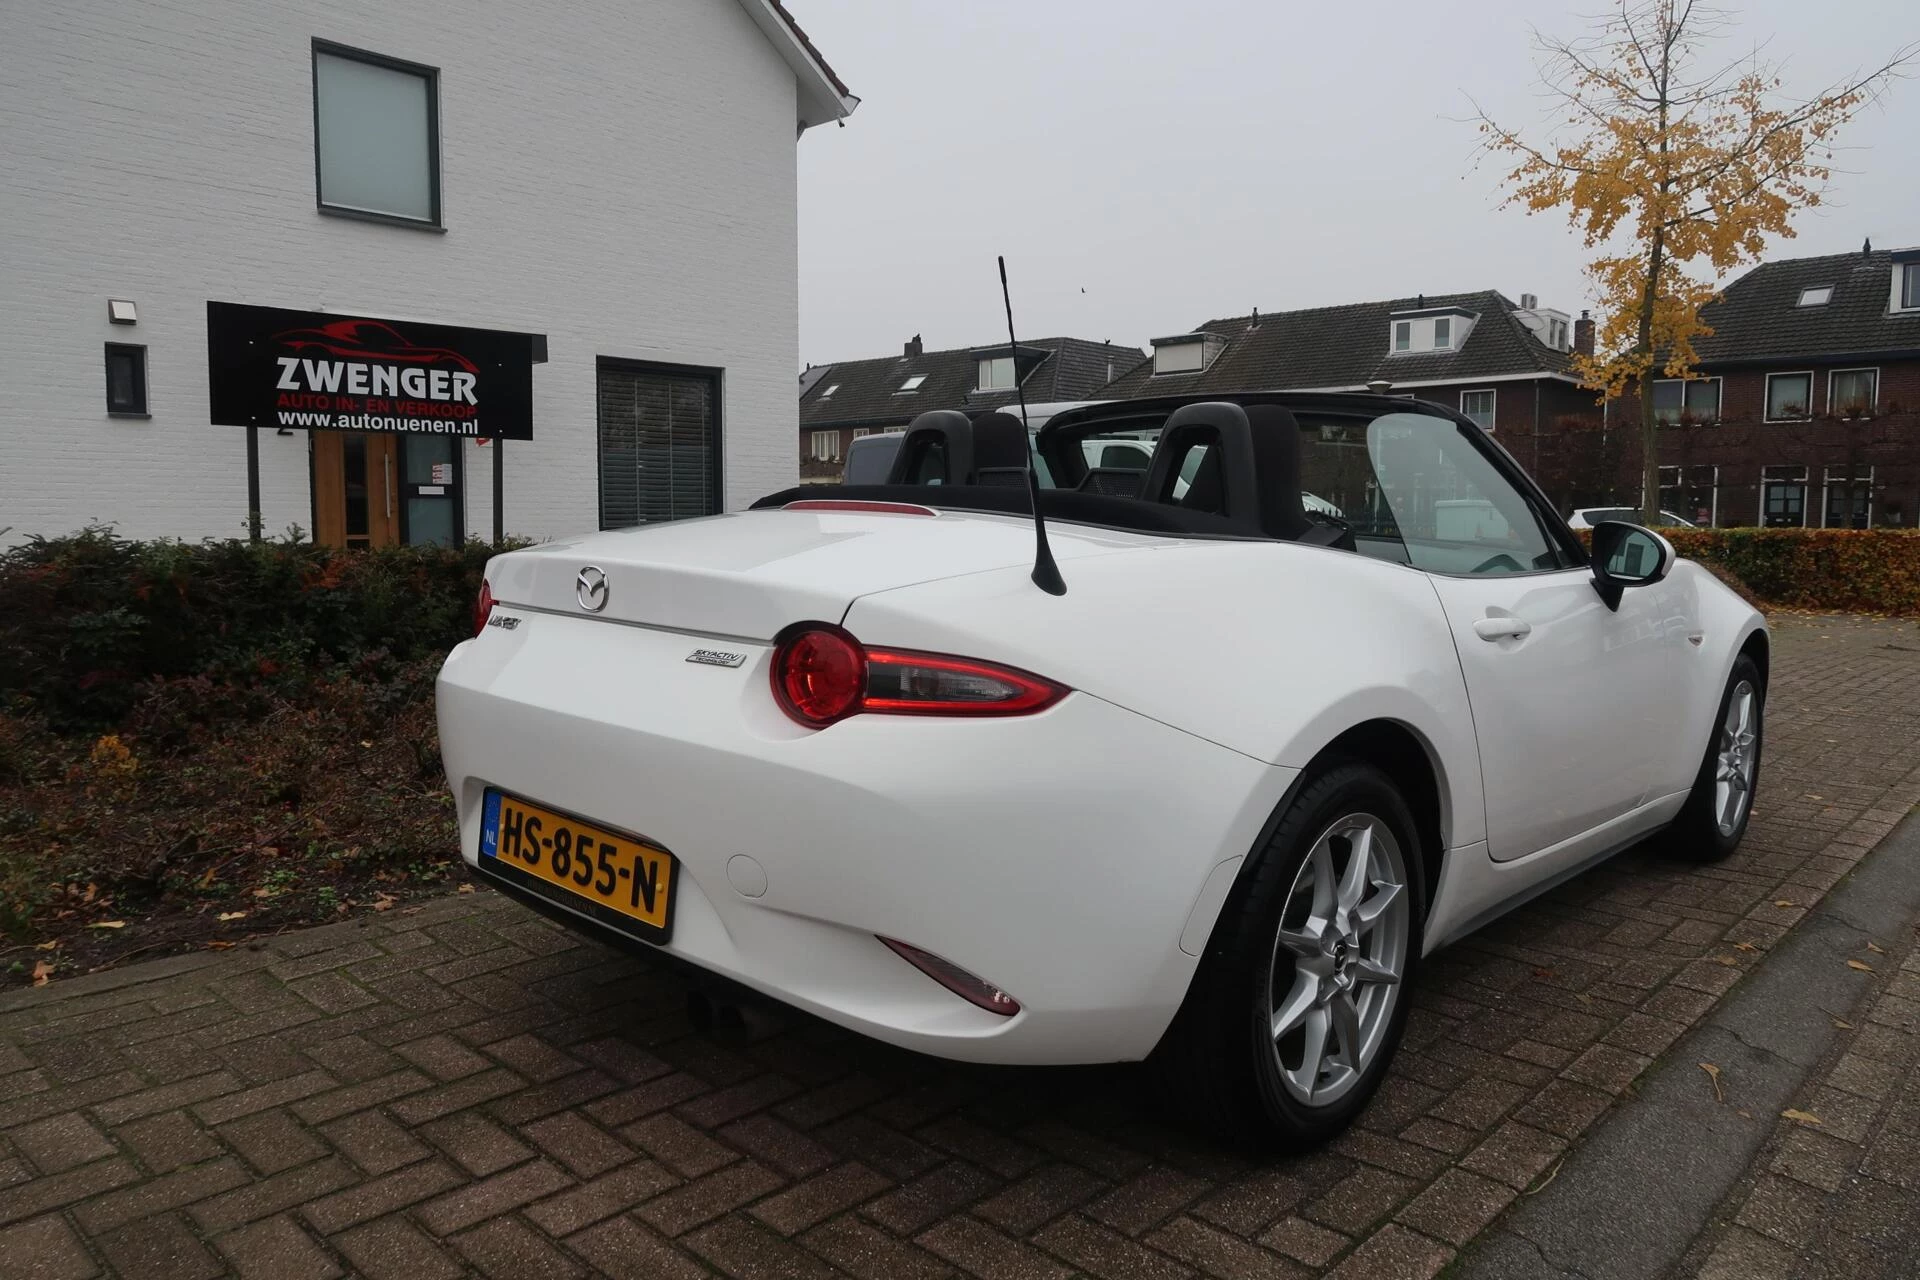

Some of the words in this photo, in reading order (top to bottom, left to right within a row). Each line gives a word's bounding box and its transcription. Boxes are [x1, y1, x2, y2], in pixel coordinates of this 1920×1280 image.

[276, 356, 478, 406] ZWENGER
[277, 393, 330, 410] AUTO
[336, 396, 360, 411] IN-
[367, 398, 390, 413] EN
[396, 401, 478, 418] VERKOOP
[278, 411, 478, 435] www.autonuenen.nl
[693, 649, 739, 660] SKYACTIV
[485, 829, 497, 846] NL
[502, 807, 659, 914] HS-855-N
